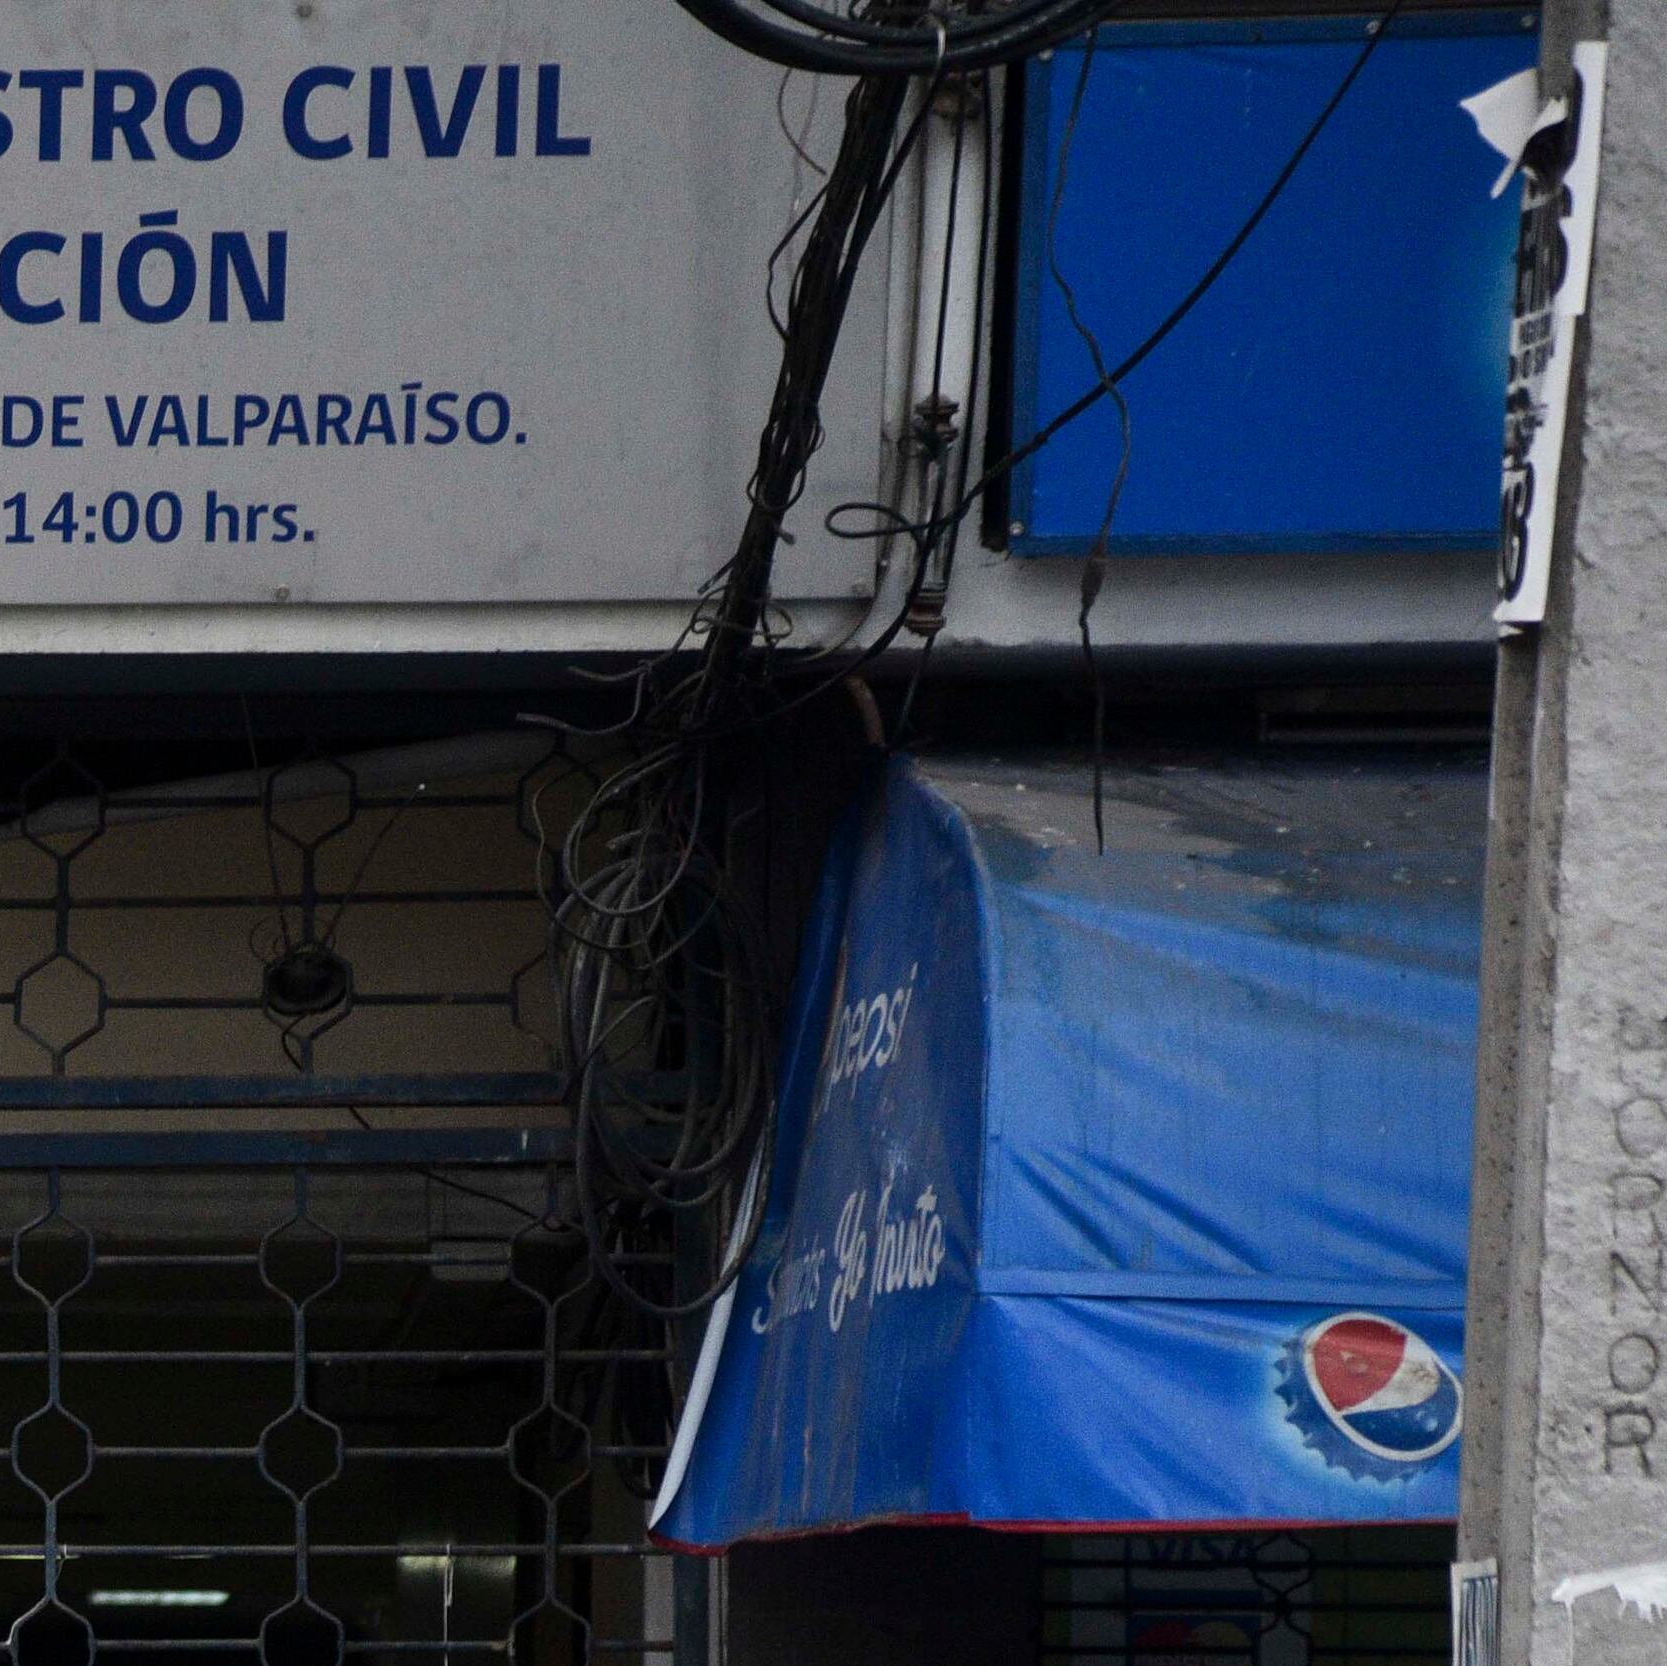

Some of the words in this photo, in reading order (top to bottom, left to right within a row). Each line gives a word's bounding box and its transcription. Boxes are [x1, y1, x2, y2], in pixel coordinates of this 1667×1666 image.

[283, 64, 591, 160] CIVIL
[2, 396, 84, 447] DE
[105, 382, 526, 446] VALPARAÍSO.
[4, 491, 182, 543] 14:00
[205, 491, 314, 542] hrs.
